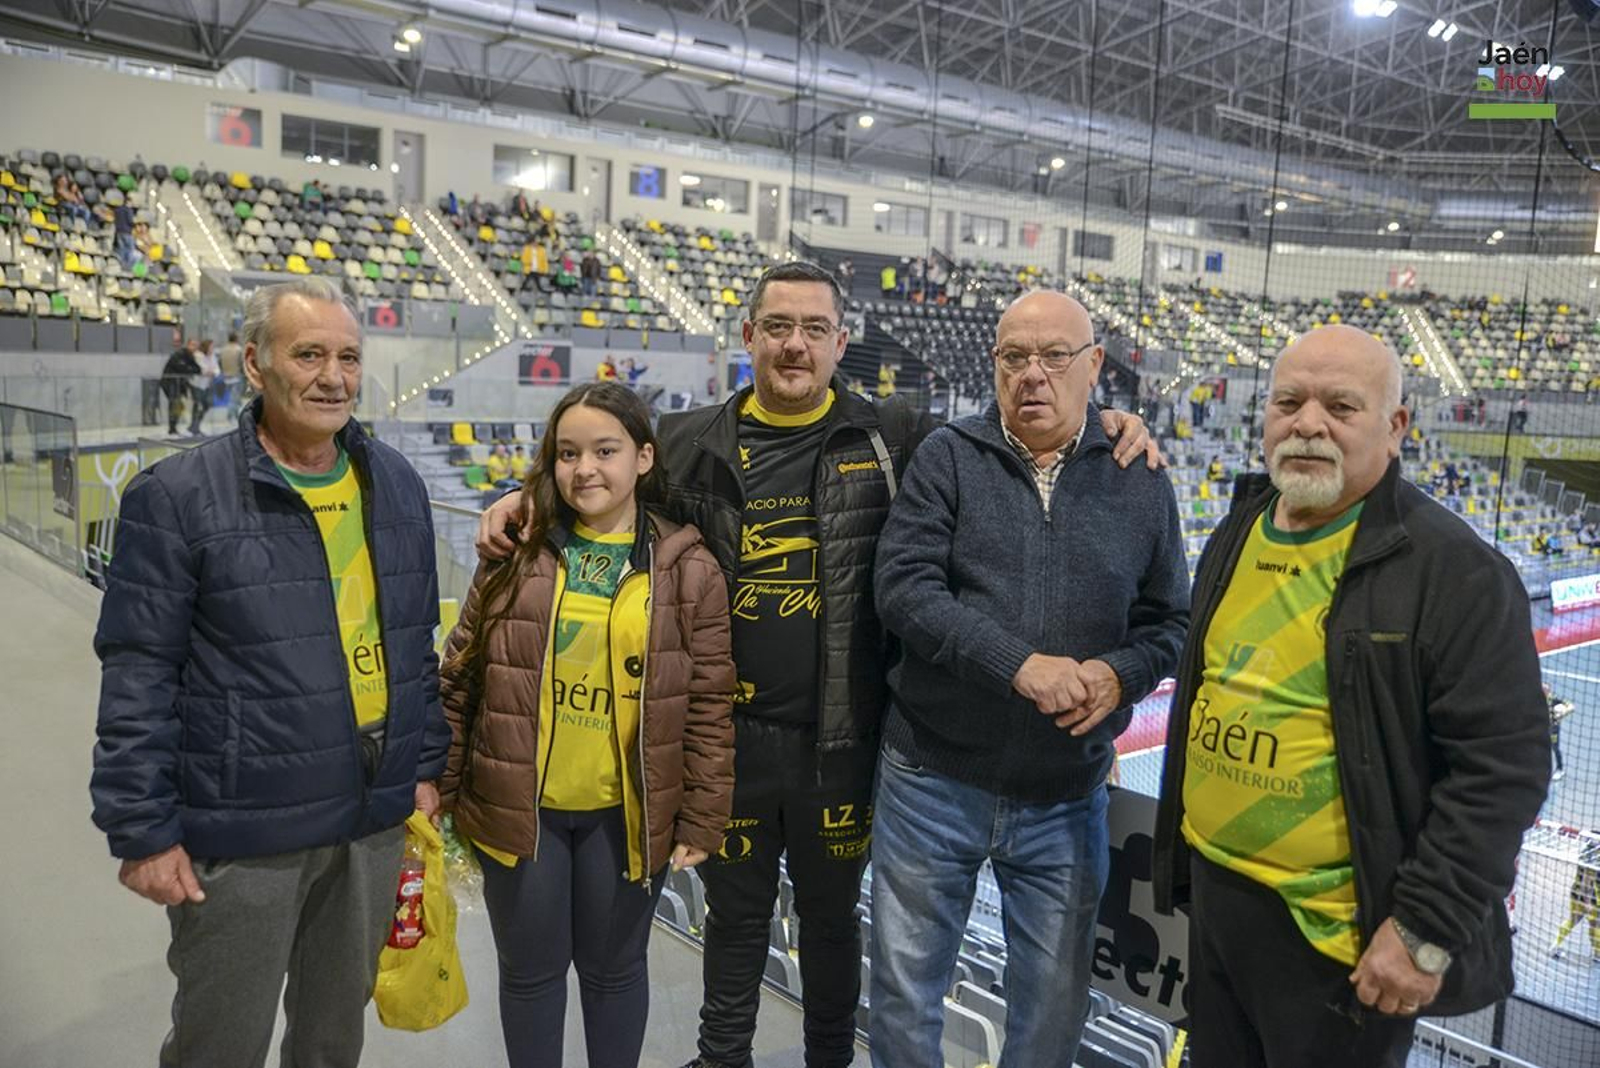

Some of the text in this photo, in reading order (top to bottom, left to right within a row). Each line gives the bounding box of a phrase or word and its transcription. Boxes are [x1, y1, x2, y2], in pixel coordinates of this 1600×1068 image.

[219, 106, 252, 148] 6
[638, 167, 659, 199] 8
[531, 346, 562, 386] 6
[746, 496, 811, 510] ACIO PARA
[579, 552, 612, 585] 12
[1190, 698, 1279, 768] Jaén
[1216, 761, 1300, 796] INTERIOR
[823, 803, 856, 829] LZ
[1091, 937, 1190, 1014] ect
